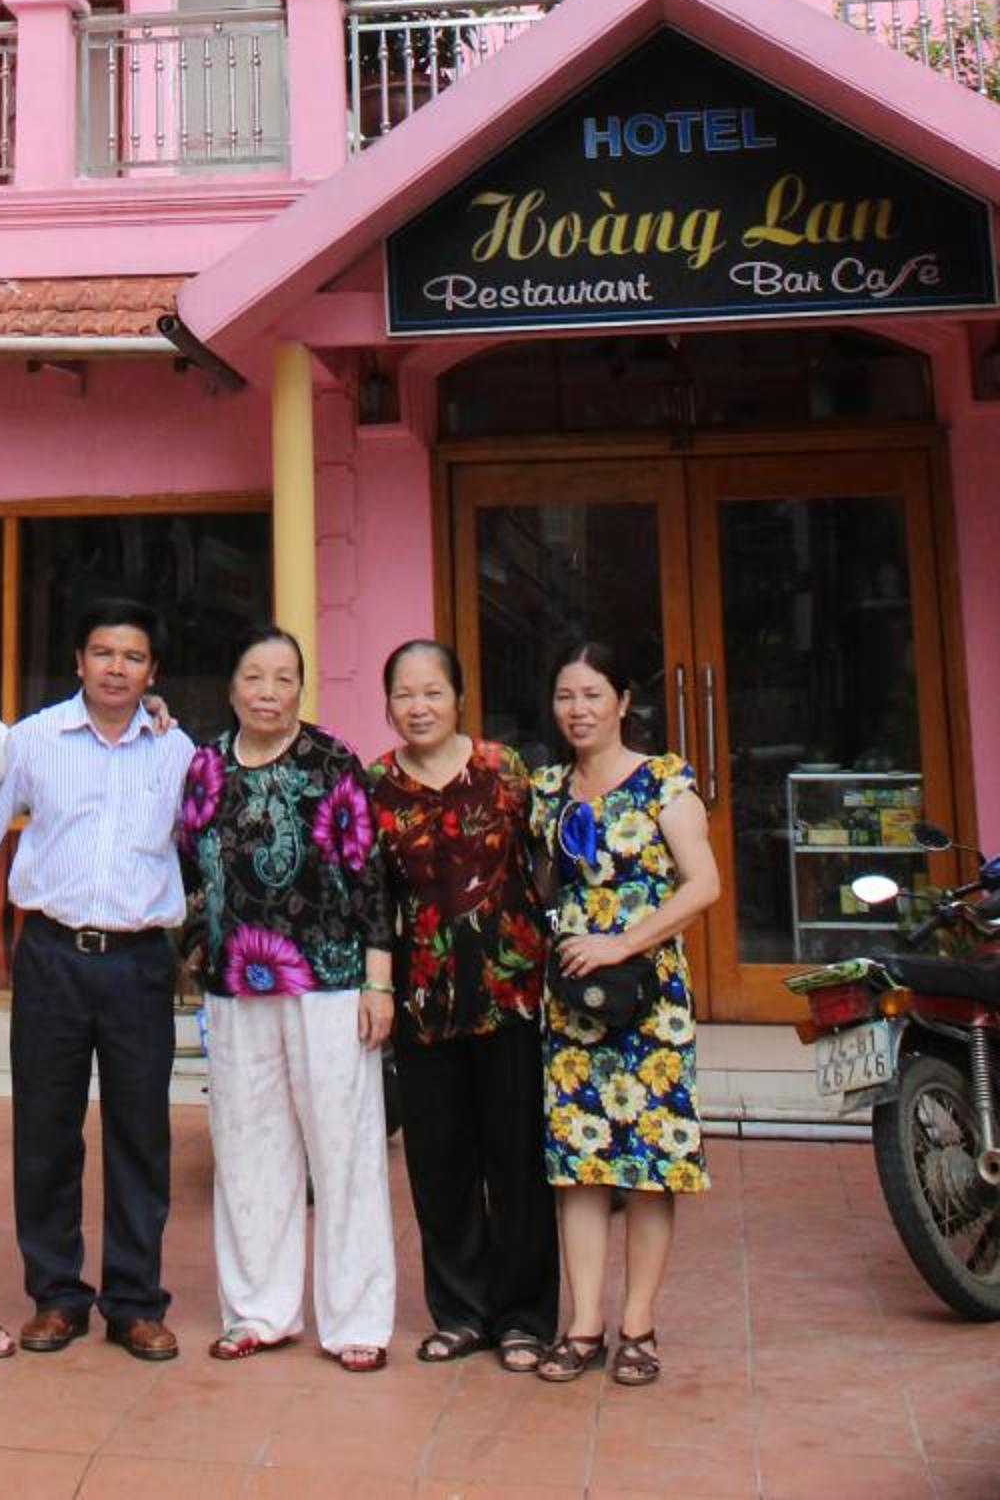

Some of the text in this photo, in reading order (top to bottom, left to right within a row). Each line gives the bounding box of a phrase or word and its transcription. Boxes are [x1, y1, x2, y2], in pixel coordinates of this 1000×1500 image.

[583, 108, 776, 159] HOTEL
[470, 173, 898, 270] Hoàng Lan
[423, 272, 653, 311] Restaurant
[729, 260, 822, 295] Bar
